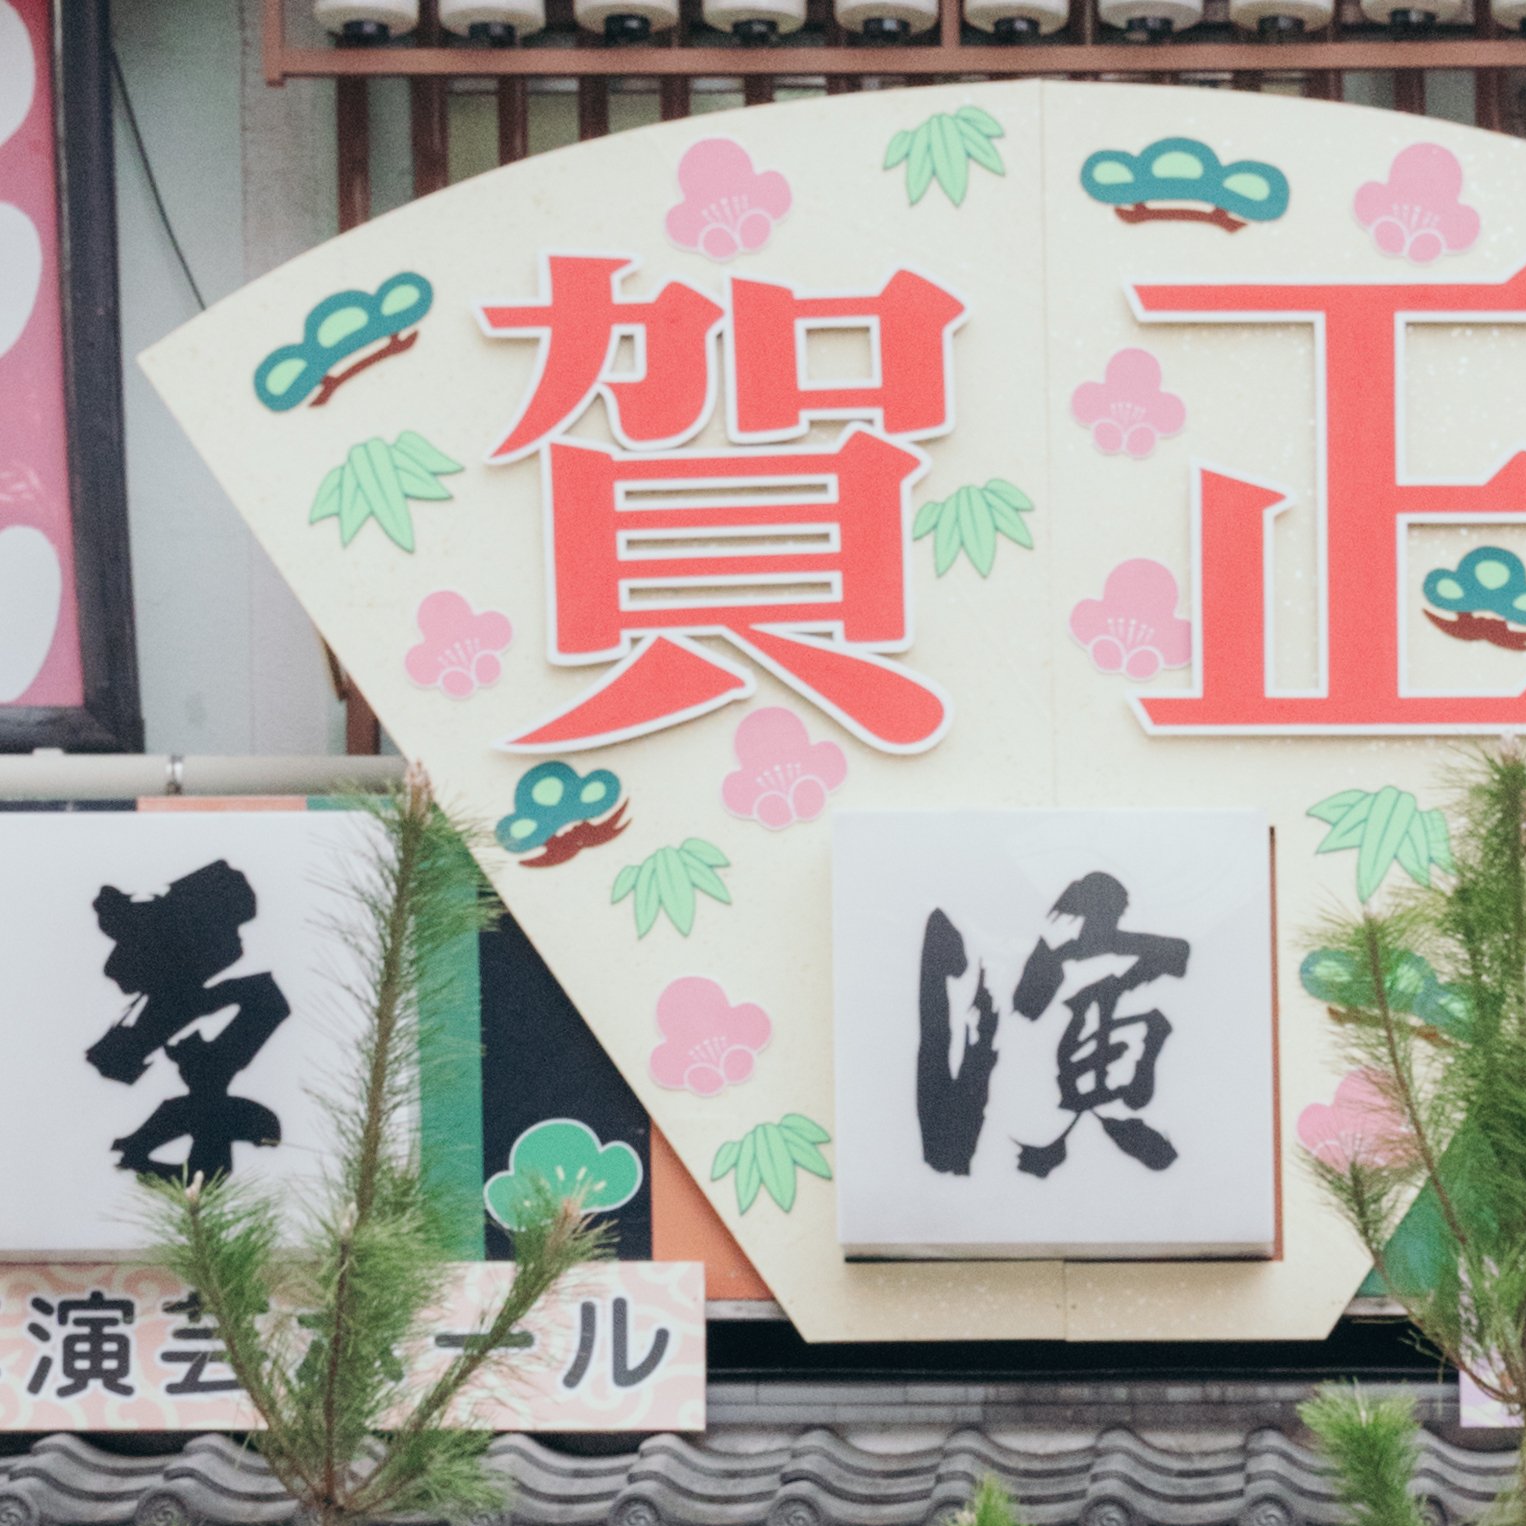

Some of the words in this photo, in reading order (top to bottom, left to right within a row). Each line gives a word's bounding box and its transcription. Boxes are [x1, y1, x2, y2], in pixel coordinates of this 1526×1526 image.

[917, 871, 1190, 1178] 演
[27, 1291, 670, 1398] 演芸ール
